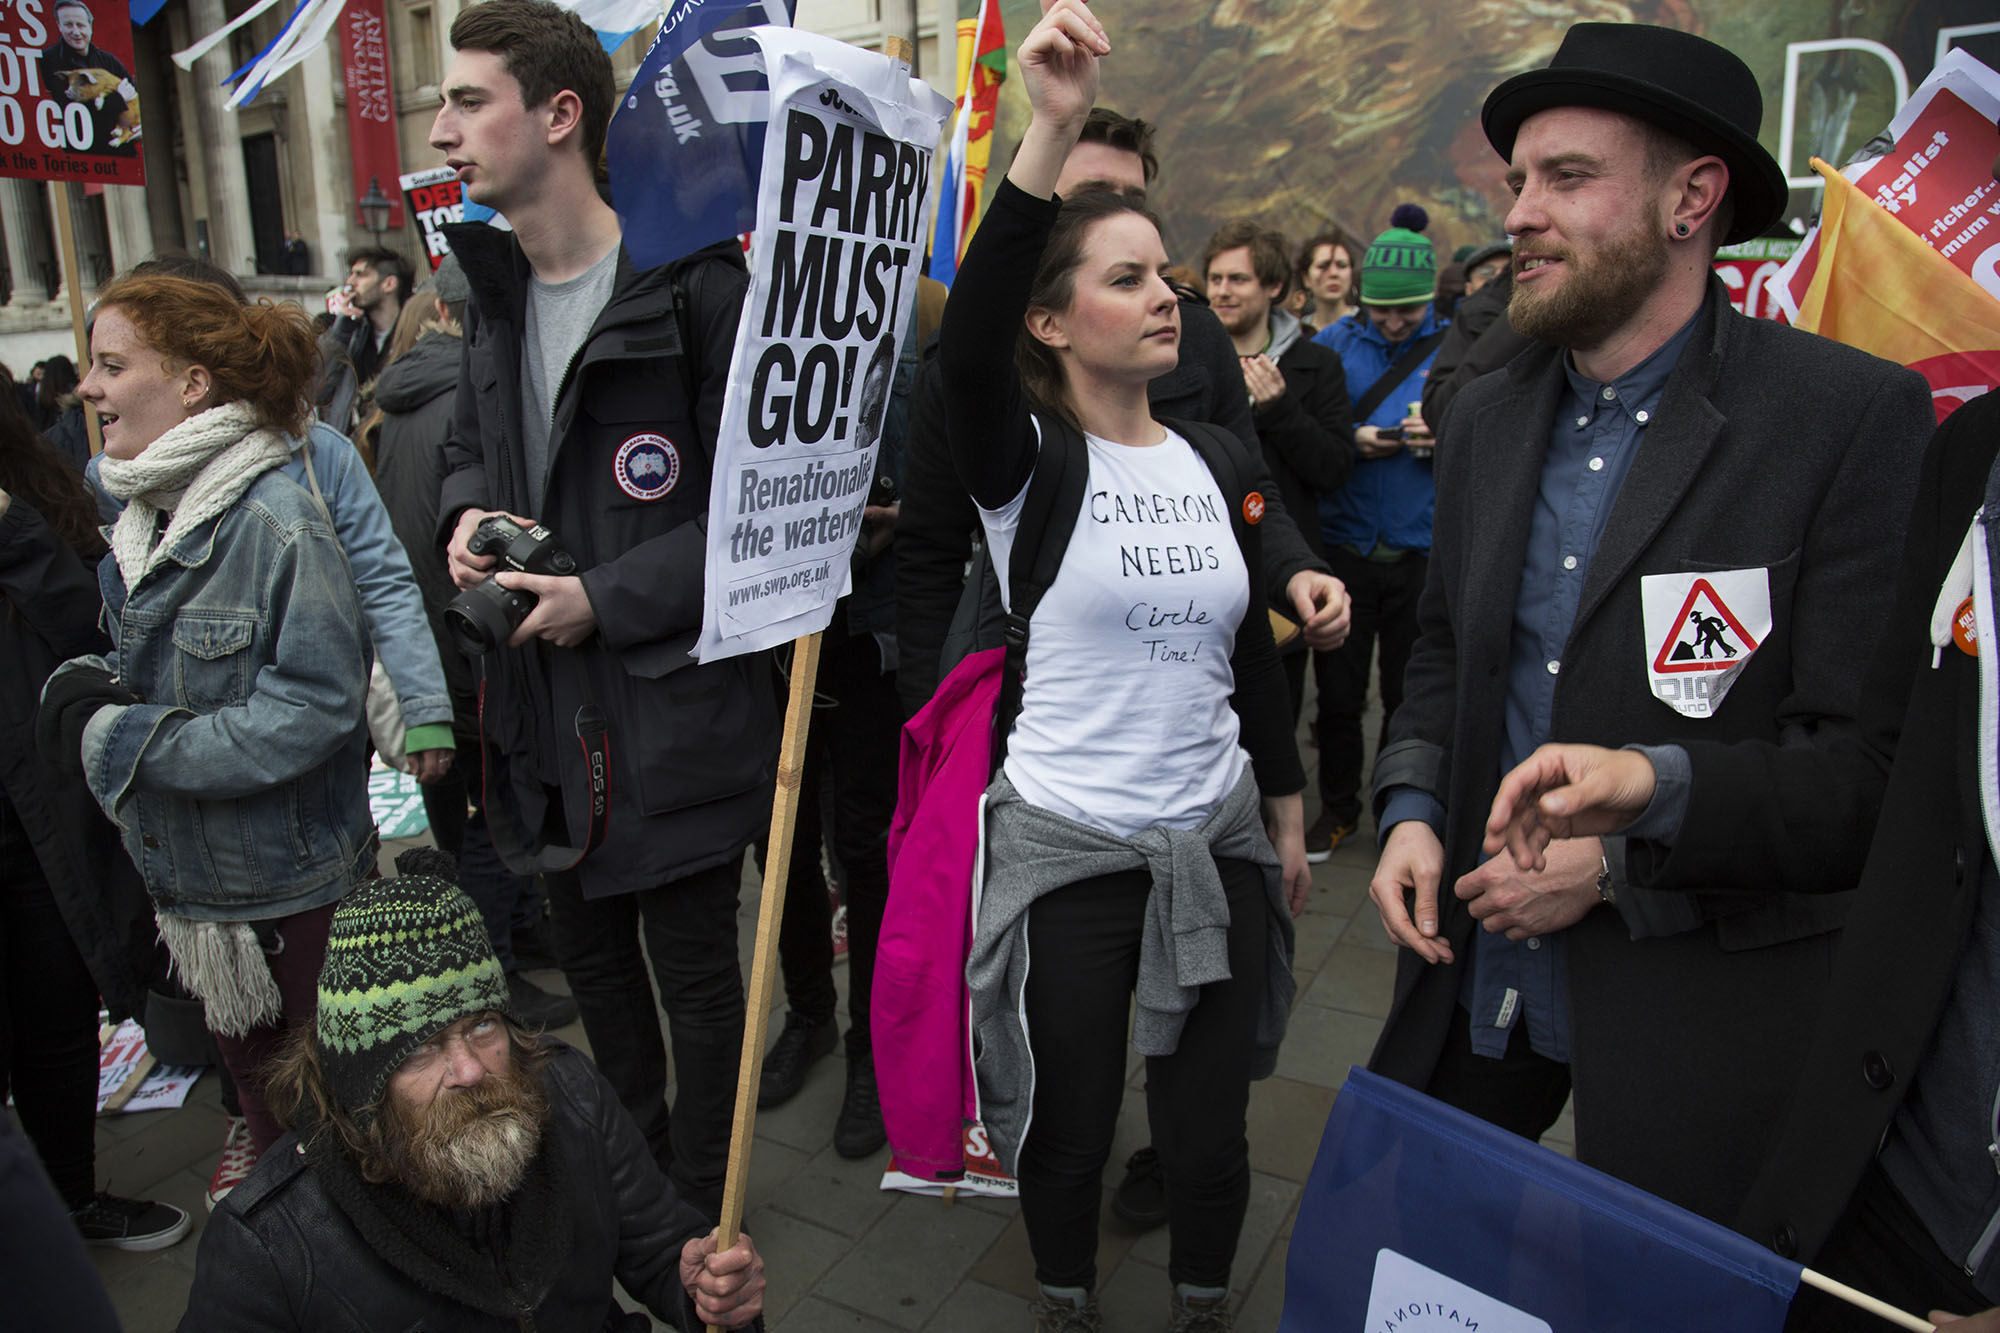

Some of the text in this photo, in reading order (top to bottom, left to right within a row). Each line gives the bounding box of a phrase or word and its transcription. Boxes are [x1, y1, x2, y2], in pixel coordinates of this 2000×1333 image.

[349, 9, 372, 119] NATIONAL
[363, 9, 390, 122] GALLERY
[36, 99, 94, 151] GO
[13, 152, 37, 170] the
[42, 154, 89, 174] Tories
[94, 159, 118, 175] out
[779, 109, 931, 244] PARRY
[761, 230, 910, 341] MUST
[748, 343, 859, 449] GO!
[1091, 491, 1220, 524] CAMERON
[730, 518, 773, 563] the
[1120, 544, 1219, 577] NEEDS
[729, 561, 831, 606] www.swp.org.uk
[1125, 600, 1214, 631] Circle
[1142, 640, 1202, 662] Time!
[592, 751, 604, 792] EOS
